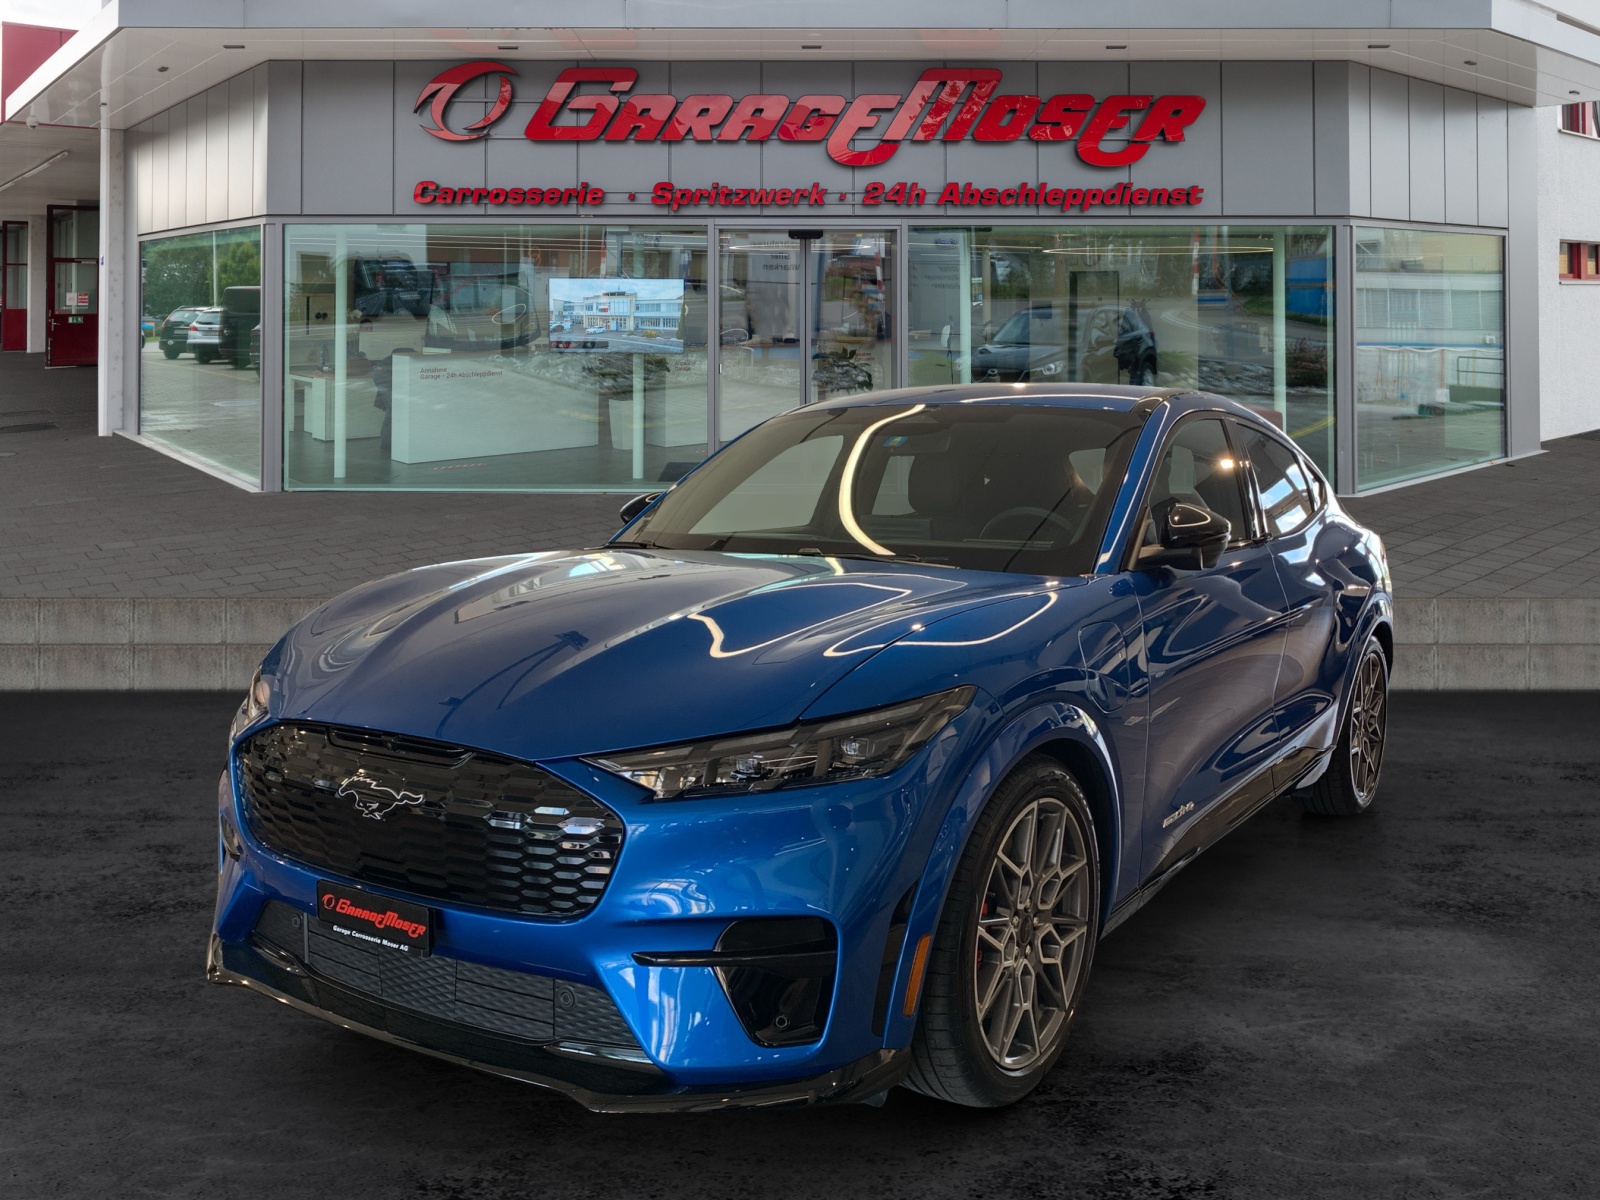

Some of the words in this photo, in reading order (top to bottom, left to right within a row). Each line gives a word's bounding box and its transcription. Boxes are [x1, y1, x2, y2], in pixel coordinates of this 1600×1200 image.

[413, 180, 604, 205] Carrosserie
[651, 181, 827, 211] Spritzwerk
[862, 181, 928, 205] 24h
[937, 181, 1204, 212] Abschleppdienst
[458, 370, 503, 378] Abschleppdienst
[333, 925, 351, 935] Garage
[351, 931, 381, 943] Carrosserie
[382, 939, 399, 949] Moser
[399, 944, 409, 952] AG
